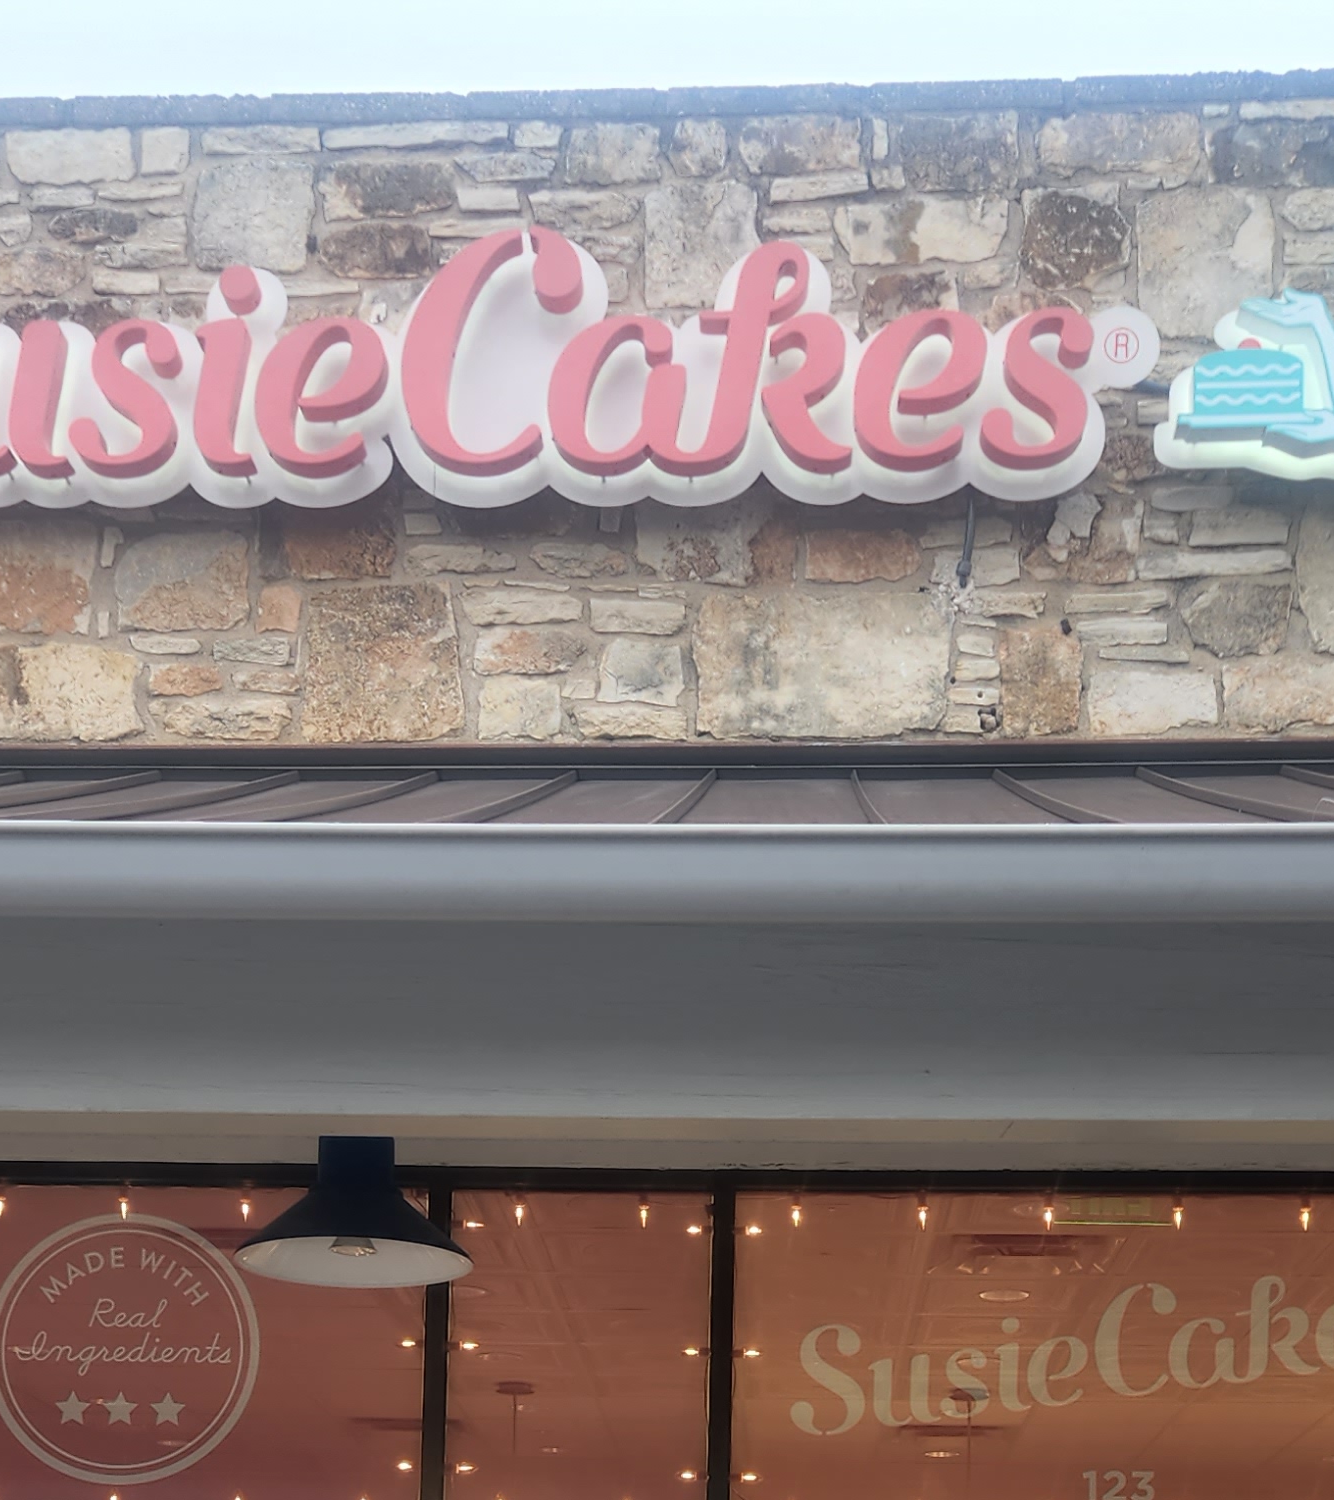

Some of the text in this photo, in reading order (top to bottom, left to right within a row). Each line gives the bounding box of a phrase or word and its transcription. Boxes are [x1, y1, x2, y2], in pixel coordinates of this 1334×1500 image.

[39, 1246, 210, 1307] MADE WITH
[89, 1297, 168, 1329] Real
[15, 1330, 232, 1377] Ingredients
